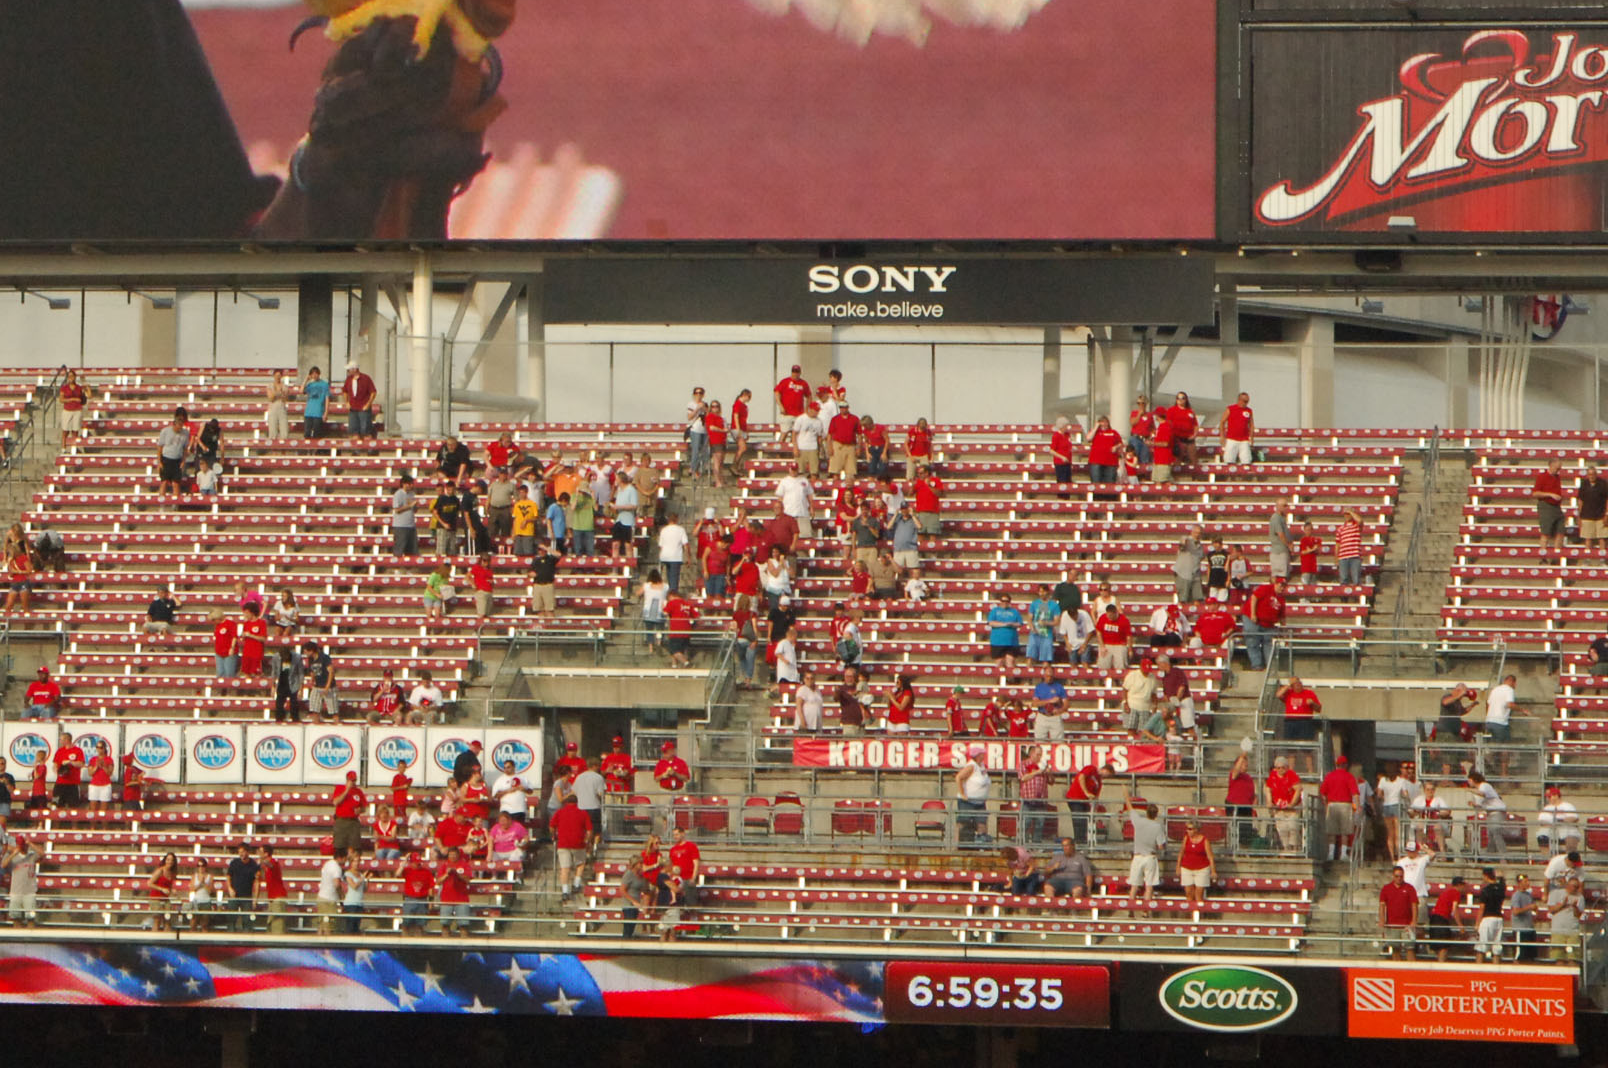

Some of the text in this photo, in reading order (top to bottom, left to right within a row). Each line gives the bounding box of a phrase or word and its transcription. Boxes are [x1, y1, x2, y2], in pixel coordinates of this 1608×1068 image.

[808, 264, 957, 293] SONY
[816, 301, 944, 318] make.believe
[137, 738, 171, 765] Kroger
[198, 739, 232, 766] Kroger
[260, 740, 293, 766] Kroger
[317, 739, 351, 765] Kroger
[828, 740, 1129, 773] KROGER SRIEOUTS
[907, 975, 1063, 1010] 6:59:35
[1178, 979, 1279, 1011] Scotts
[1470, 980, 1497, 993] PPG
[1402, 994, 1567, 1017] PORTER PAINTS
[1402, 1024, 1428, 1036] Every
[1429, 1025, 1444, 1035] Job
[1445, 1025, 1485, 1036] Deserves
[1487, 1027, 1506, 1036] PPG
[1507, 1028, 1535, 1037] Porter
